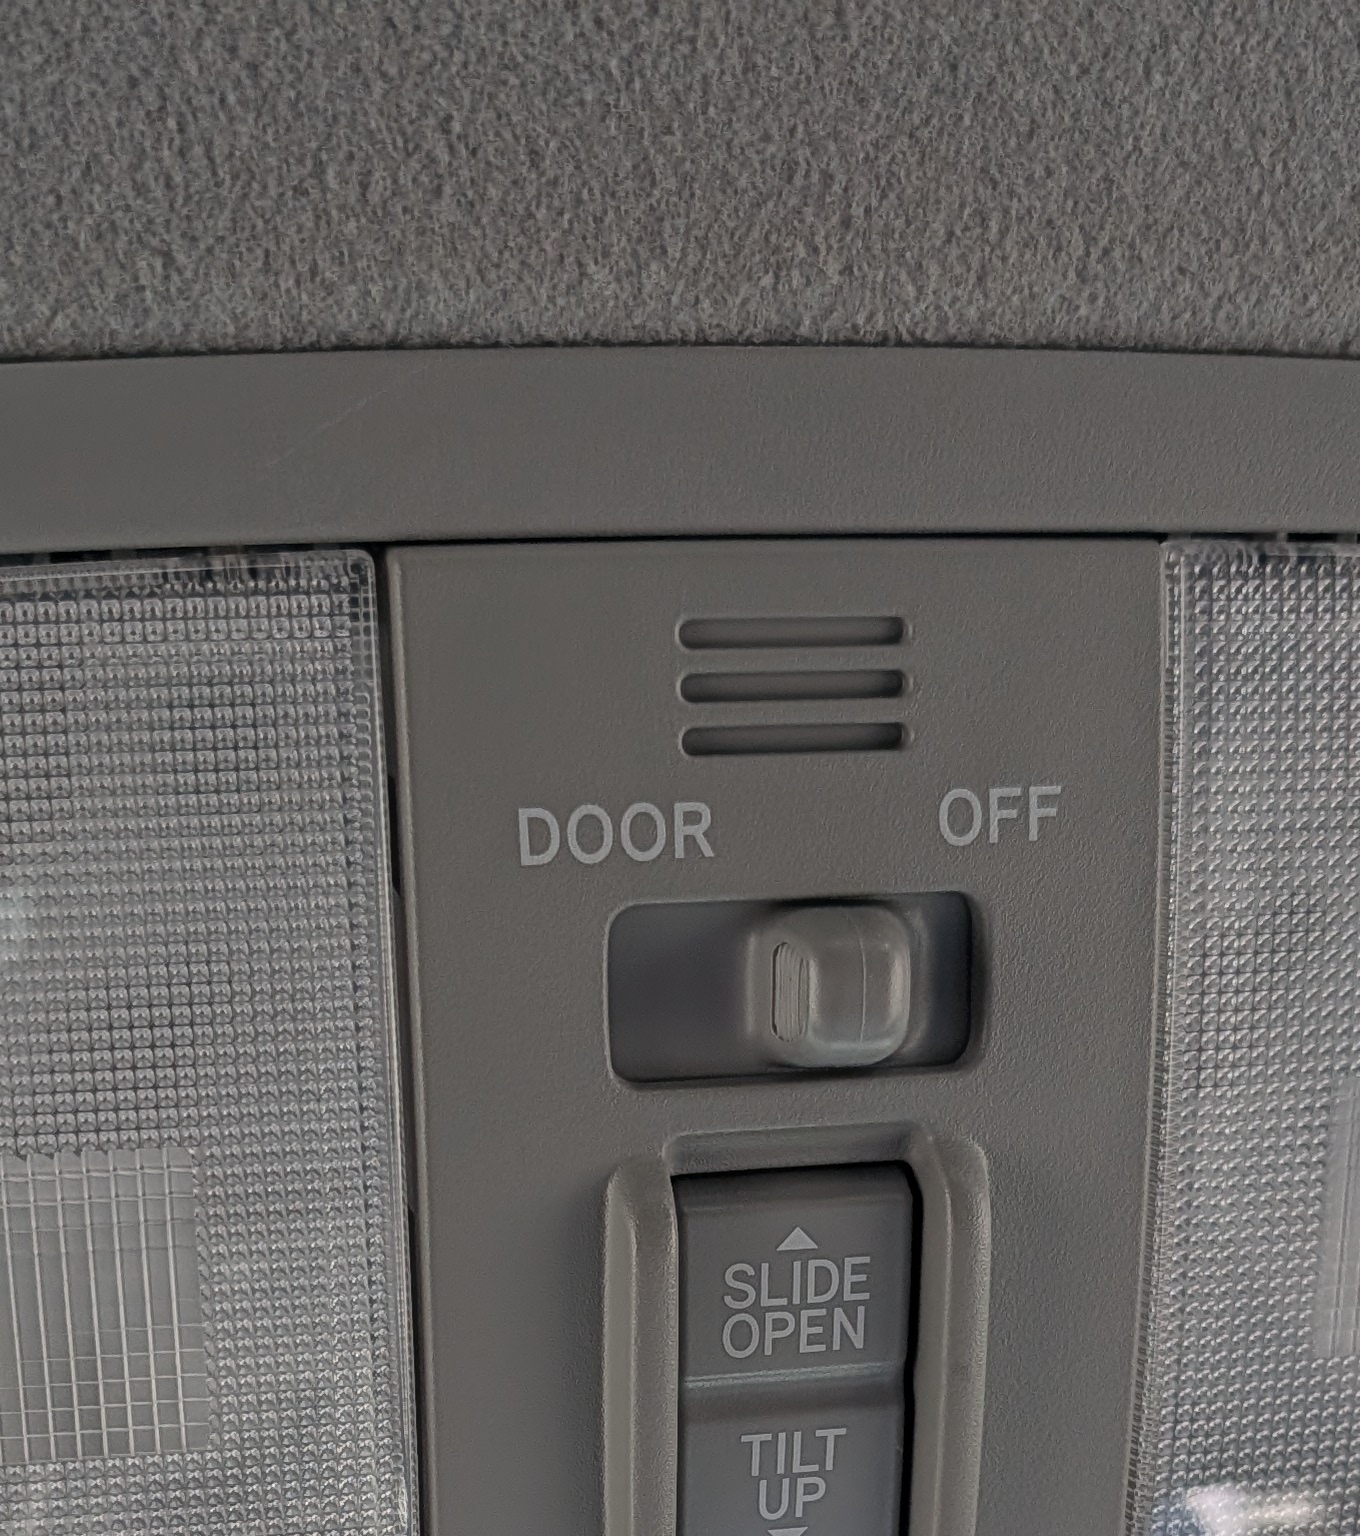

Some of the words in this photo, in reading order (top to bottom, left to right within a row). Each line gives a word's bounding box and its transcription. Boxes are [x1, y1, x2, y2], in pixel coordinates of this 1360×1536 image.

[517, 801, 715, 866] DOOR
[939, 784, 1062, 847] OFF
[722, 1255, 872, 1310] SLIDE
[721, 1305, 866, 1359] OPEN
[740, 1427, 847, 1477] TILT
[757, 1476, 827, 1521] UP
